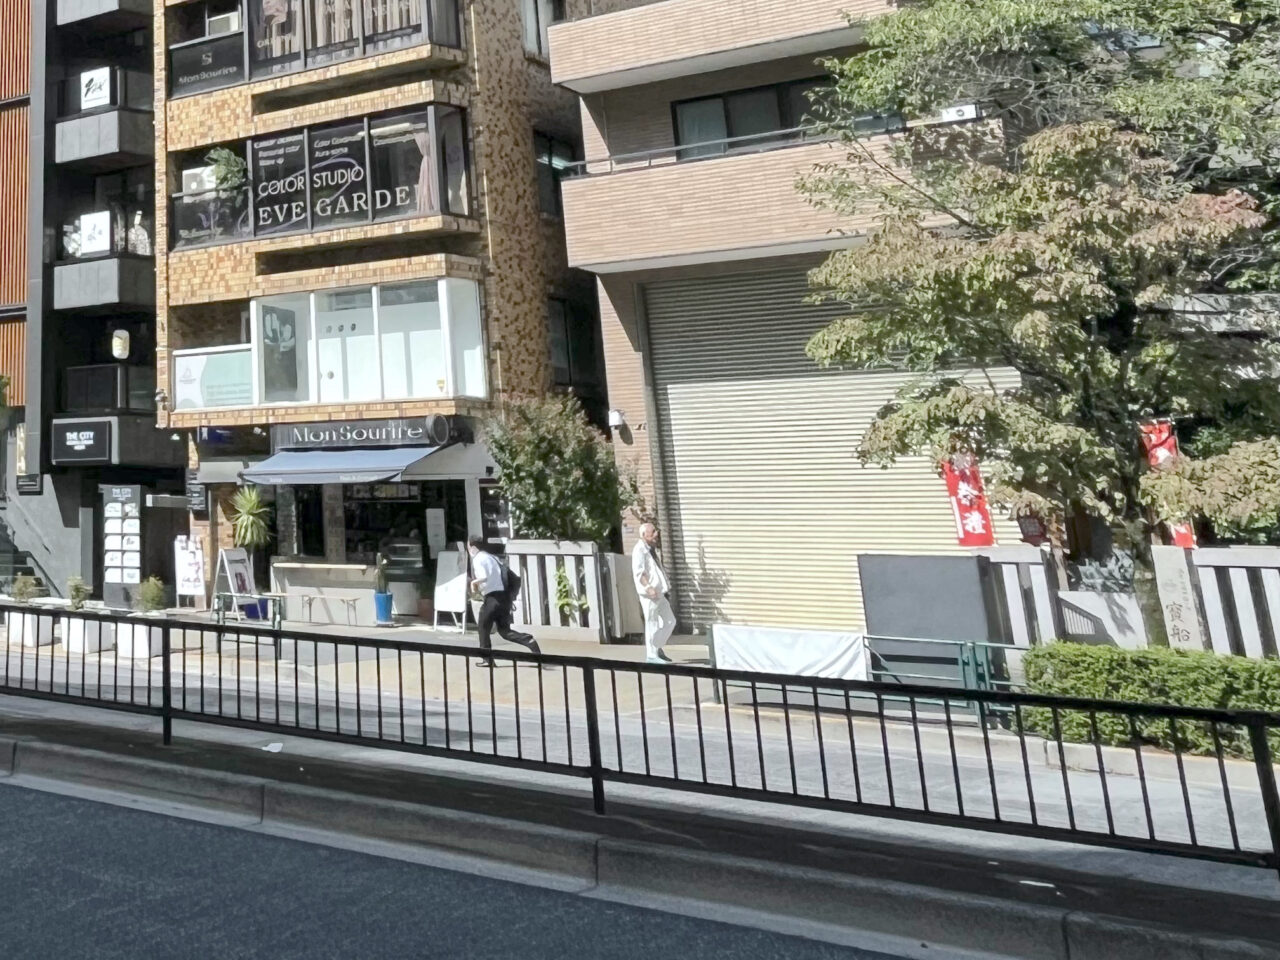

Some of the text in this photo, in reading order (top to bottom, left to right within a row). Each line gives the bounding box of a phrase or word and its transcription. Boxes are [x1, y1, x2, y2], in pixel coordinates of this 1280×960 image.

[258, 166, 364, 196] COLOR STUDIO
[258, 183, 421, 226] EVE GARDE
[79, 431, 95, 440] CITY
